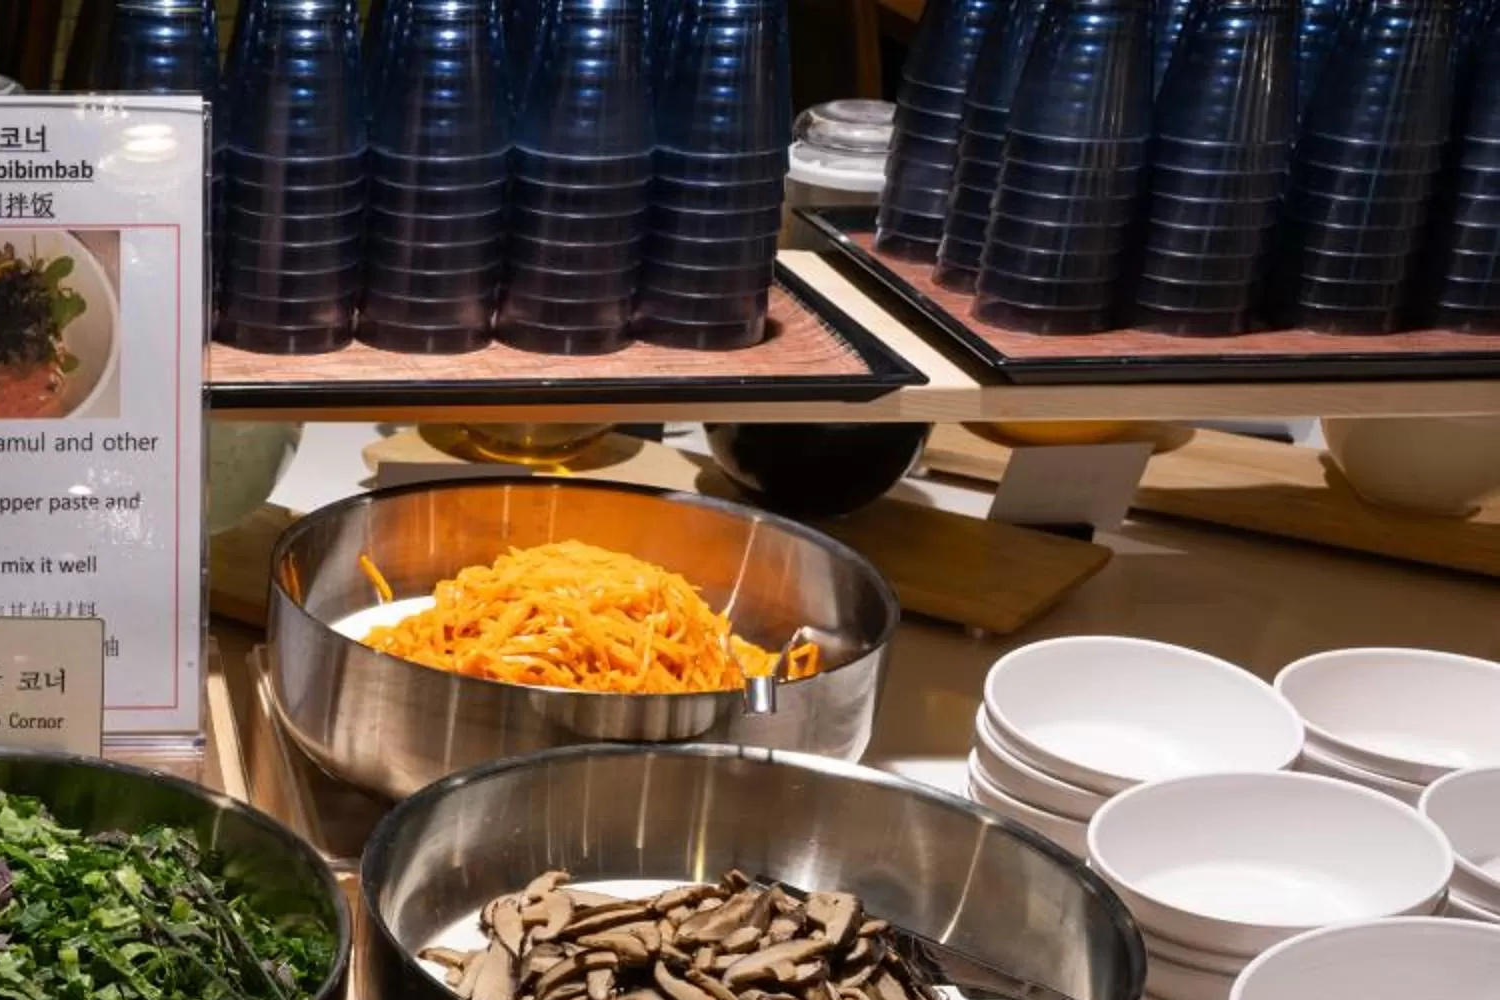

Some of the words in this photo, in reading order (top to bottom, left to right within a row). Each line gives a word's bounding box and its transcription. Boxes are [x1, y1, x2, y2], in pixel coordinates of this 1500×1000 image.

[0, 125, 47, 150] 코너
[55, 433, 93, 452] and
[103, 433, 159, 452] other
[49, 495, 99, 514] paste
[105, 492, 141, 510] and
[1, 557, 34, 574] mix
[40, 557, 53, 574] it
[59, 556, 98, 574] well
[18, 668, 66, 694] 코너
